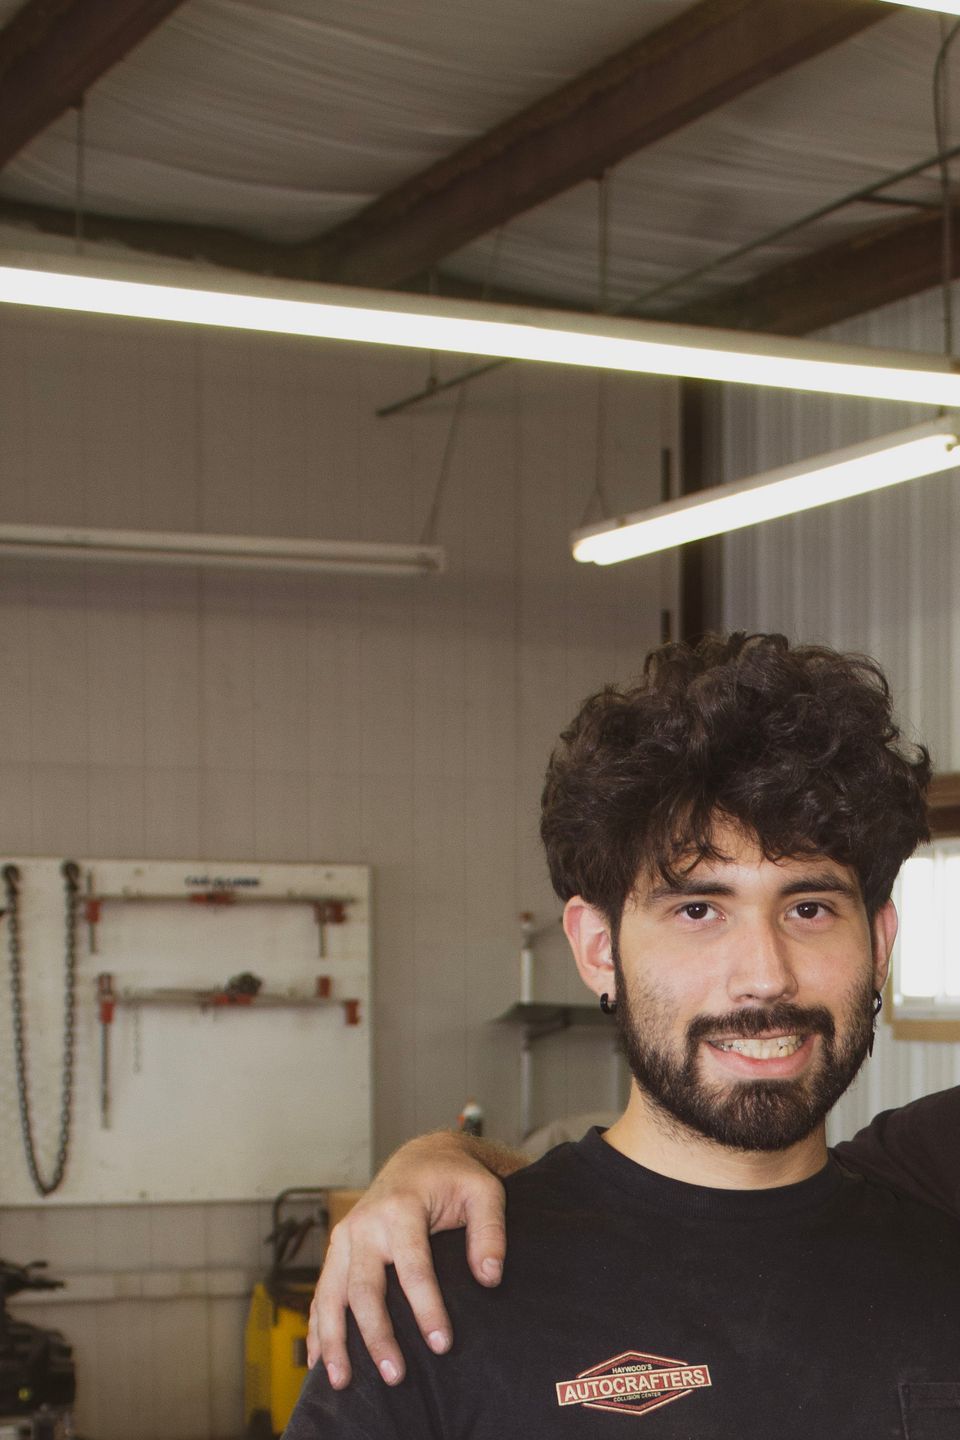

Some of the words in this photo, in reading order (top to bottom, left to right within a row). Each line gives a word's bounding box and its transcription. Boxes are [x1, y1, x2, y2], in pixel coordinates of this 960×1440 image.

[612, 1363, 653, 1374] HAYWOOD'S
[564, 1369, 706, 1402] AUTOCRAFTERS
[613, 1394, 641, 1403] COLLISION
[641, 1391, 661, 1399] CENTER
